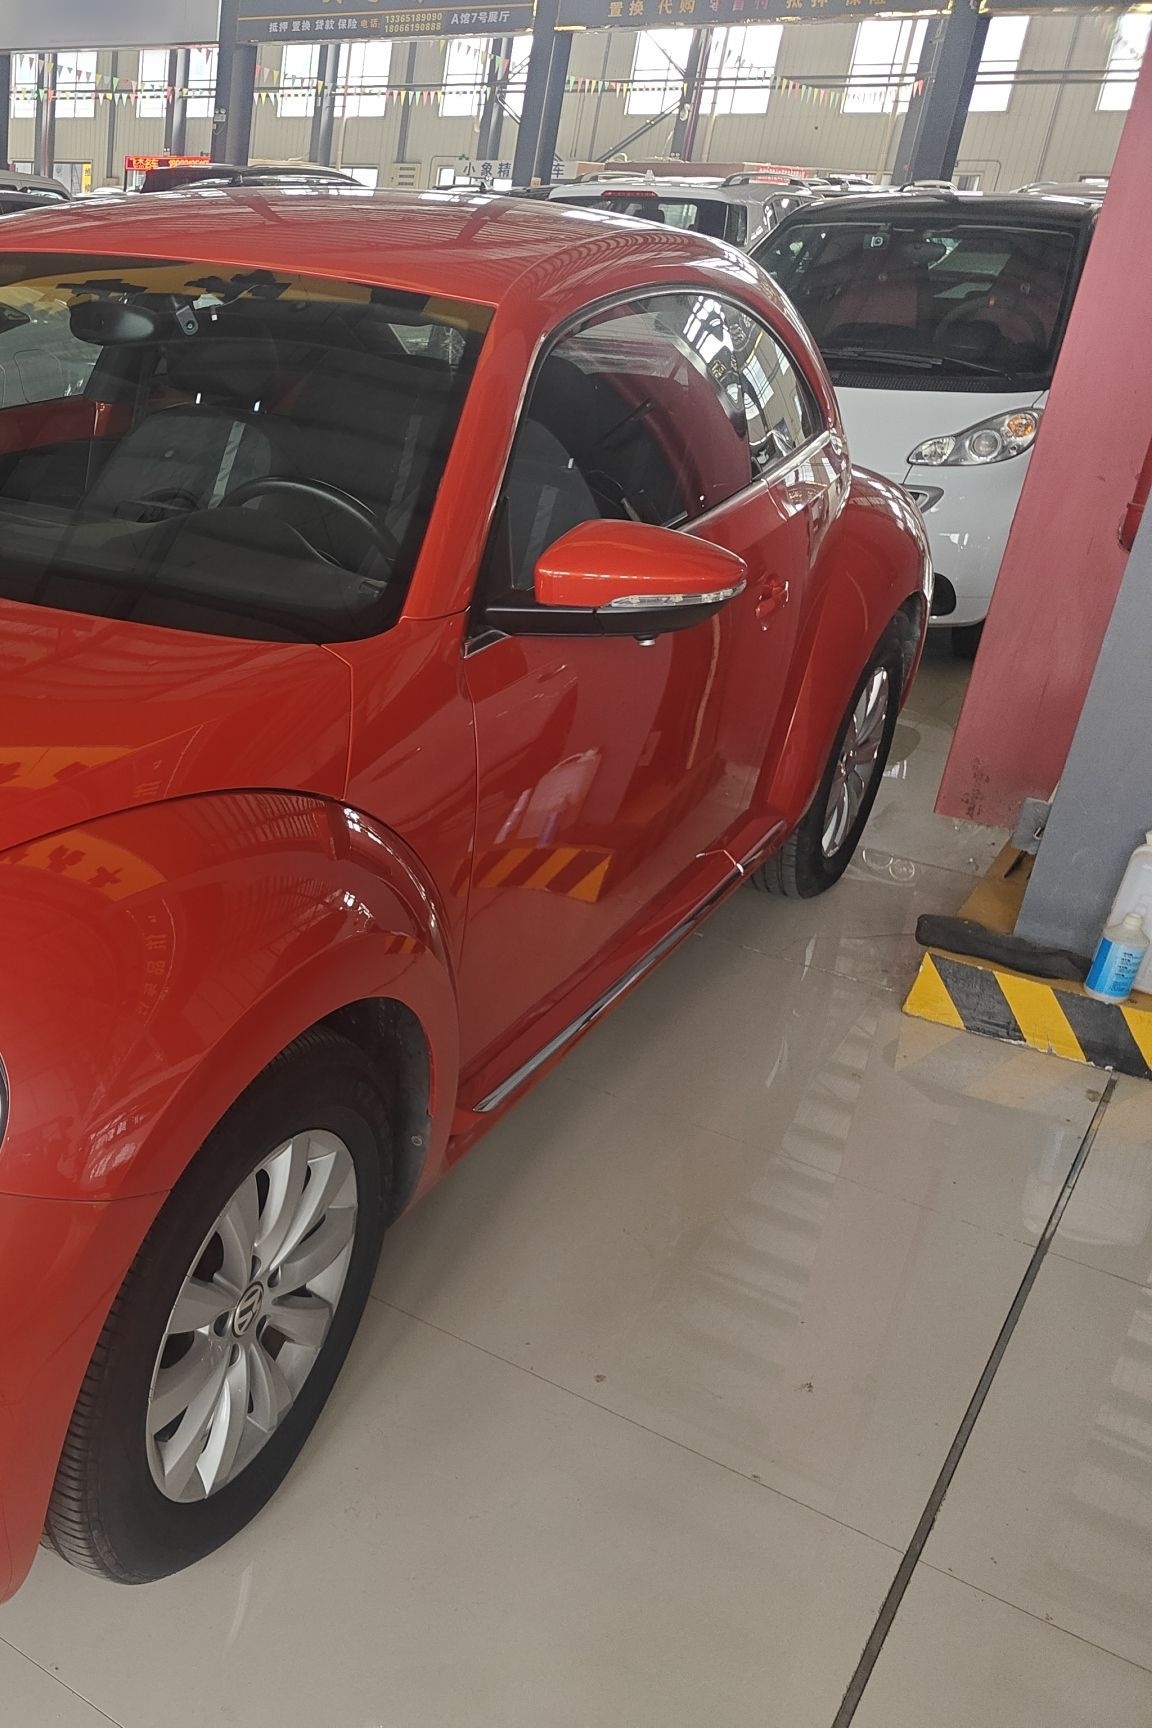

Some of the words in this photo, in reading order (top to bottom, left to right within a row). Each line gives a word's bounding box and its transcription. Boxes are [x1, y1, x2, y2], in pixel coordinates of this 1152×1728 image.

[450, 11, 510, 25] A馆7号展厅
[269, 22, 288, 33] 抵押
[291, 20, 311, 32] 置换
[315, 19, 334, 31] 贷款
[338, 18, 358, 30] 保险
